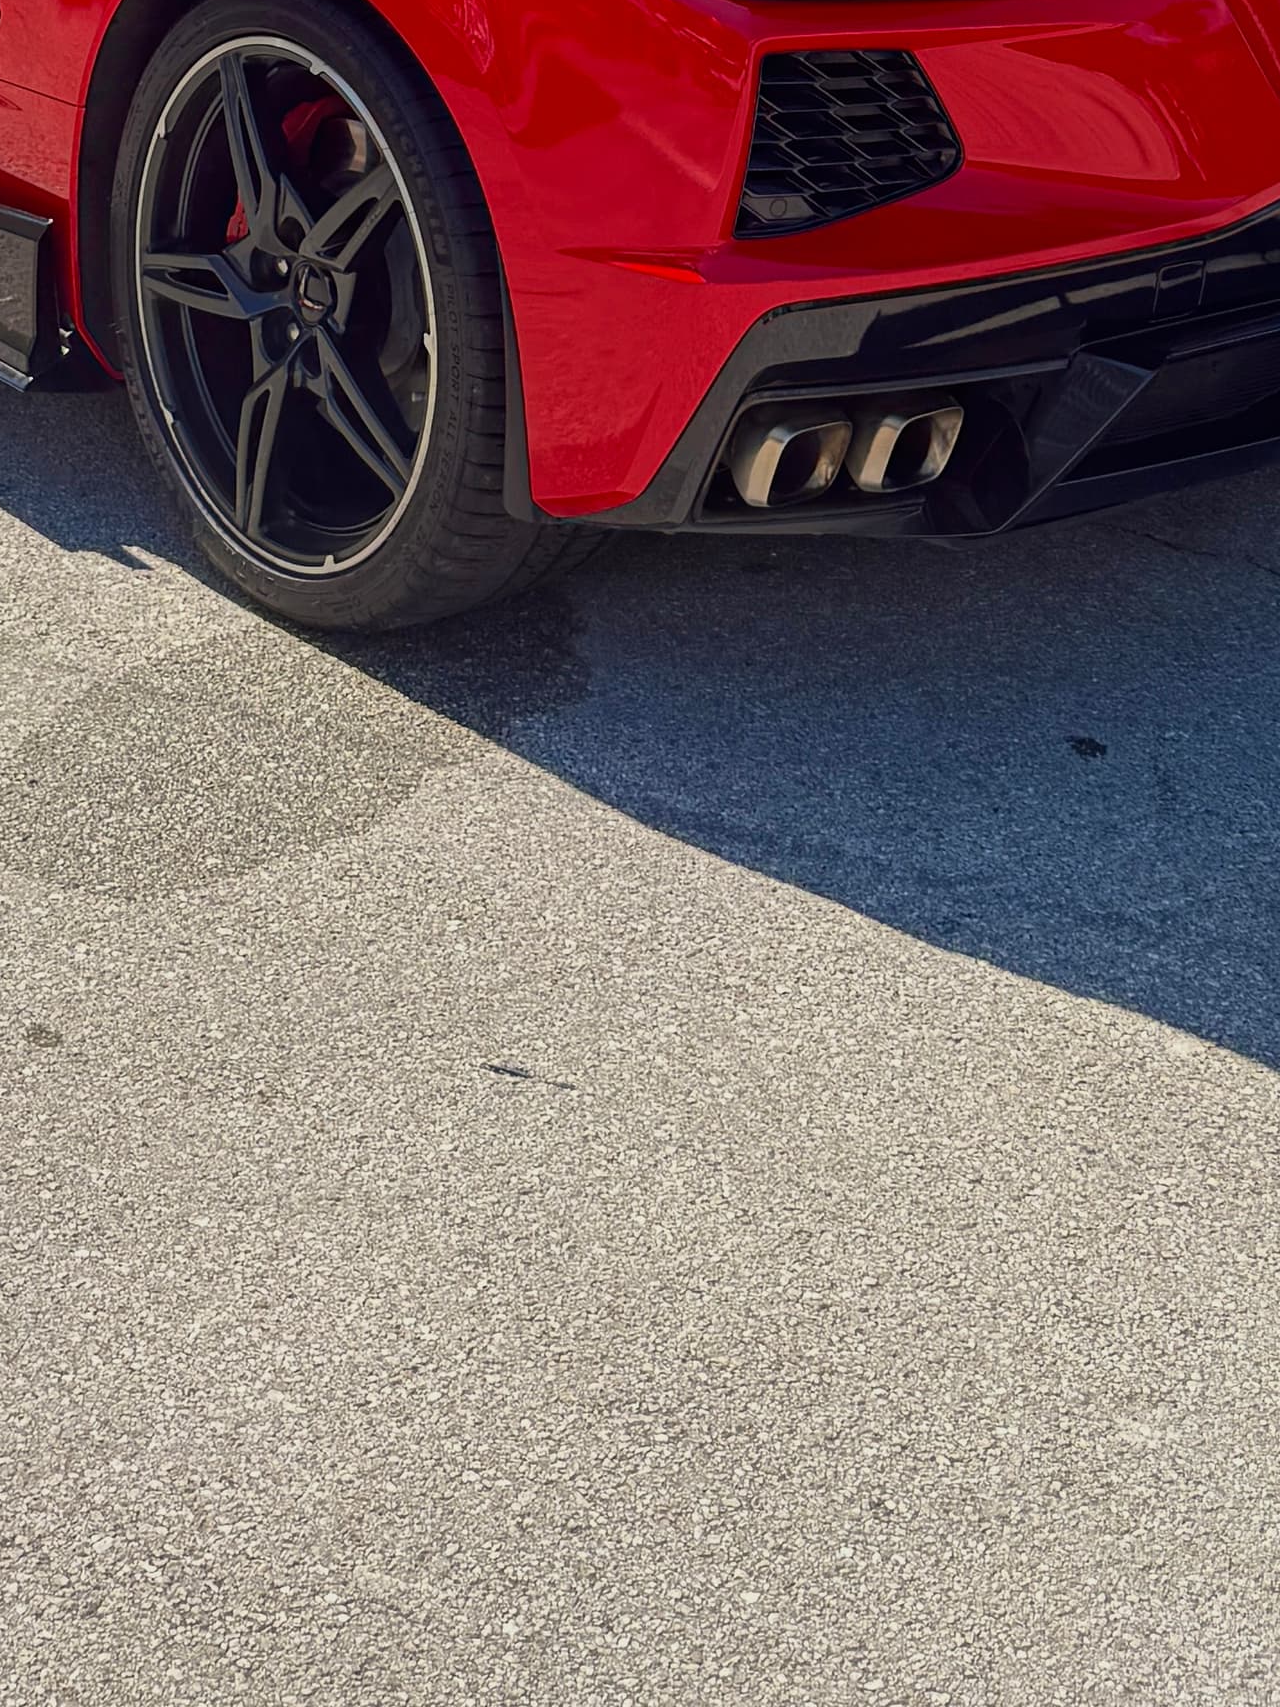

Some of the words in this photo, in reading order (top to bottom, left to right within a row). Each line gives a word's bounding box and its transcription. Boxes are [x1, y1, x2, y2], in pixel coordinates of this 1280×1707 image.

[444, 281, 459, 335] PILOT
[448, 343, 461, 403] SPORT
[445, 410, 459, 440] ALL
